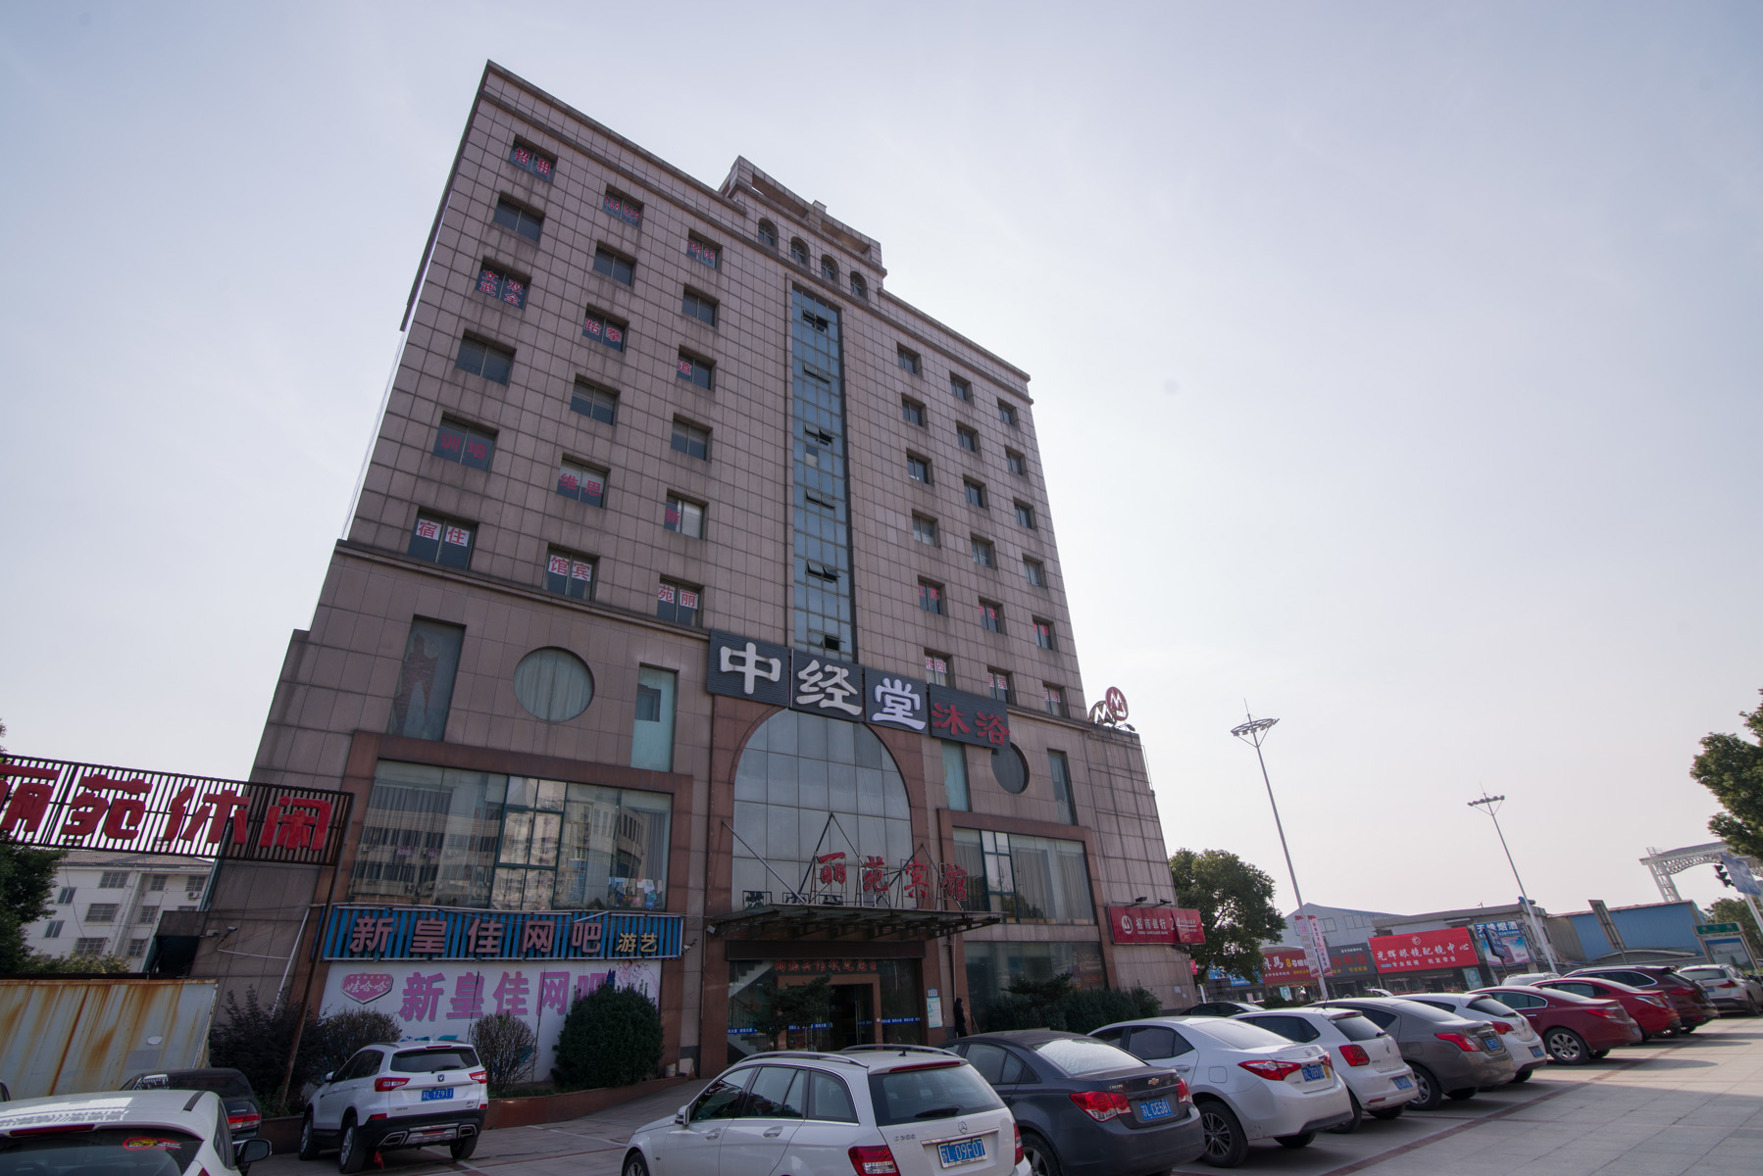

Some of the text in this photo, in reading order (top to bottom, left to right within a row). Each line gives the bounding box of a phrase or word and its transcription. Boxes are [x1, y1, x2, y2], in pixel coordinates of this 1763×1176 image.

[514, 147, 551, 175] 招租
[719, 642, 1010, 746] 中经堂 沐浴
[816, 851, 968, 899] 丽苑宾馆
[349, 914, 658, 953] 新皇佳网吧 游艺
